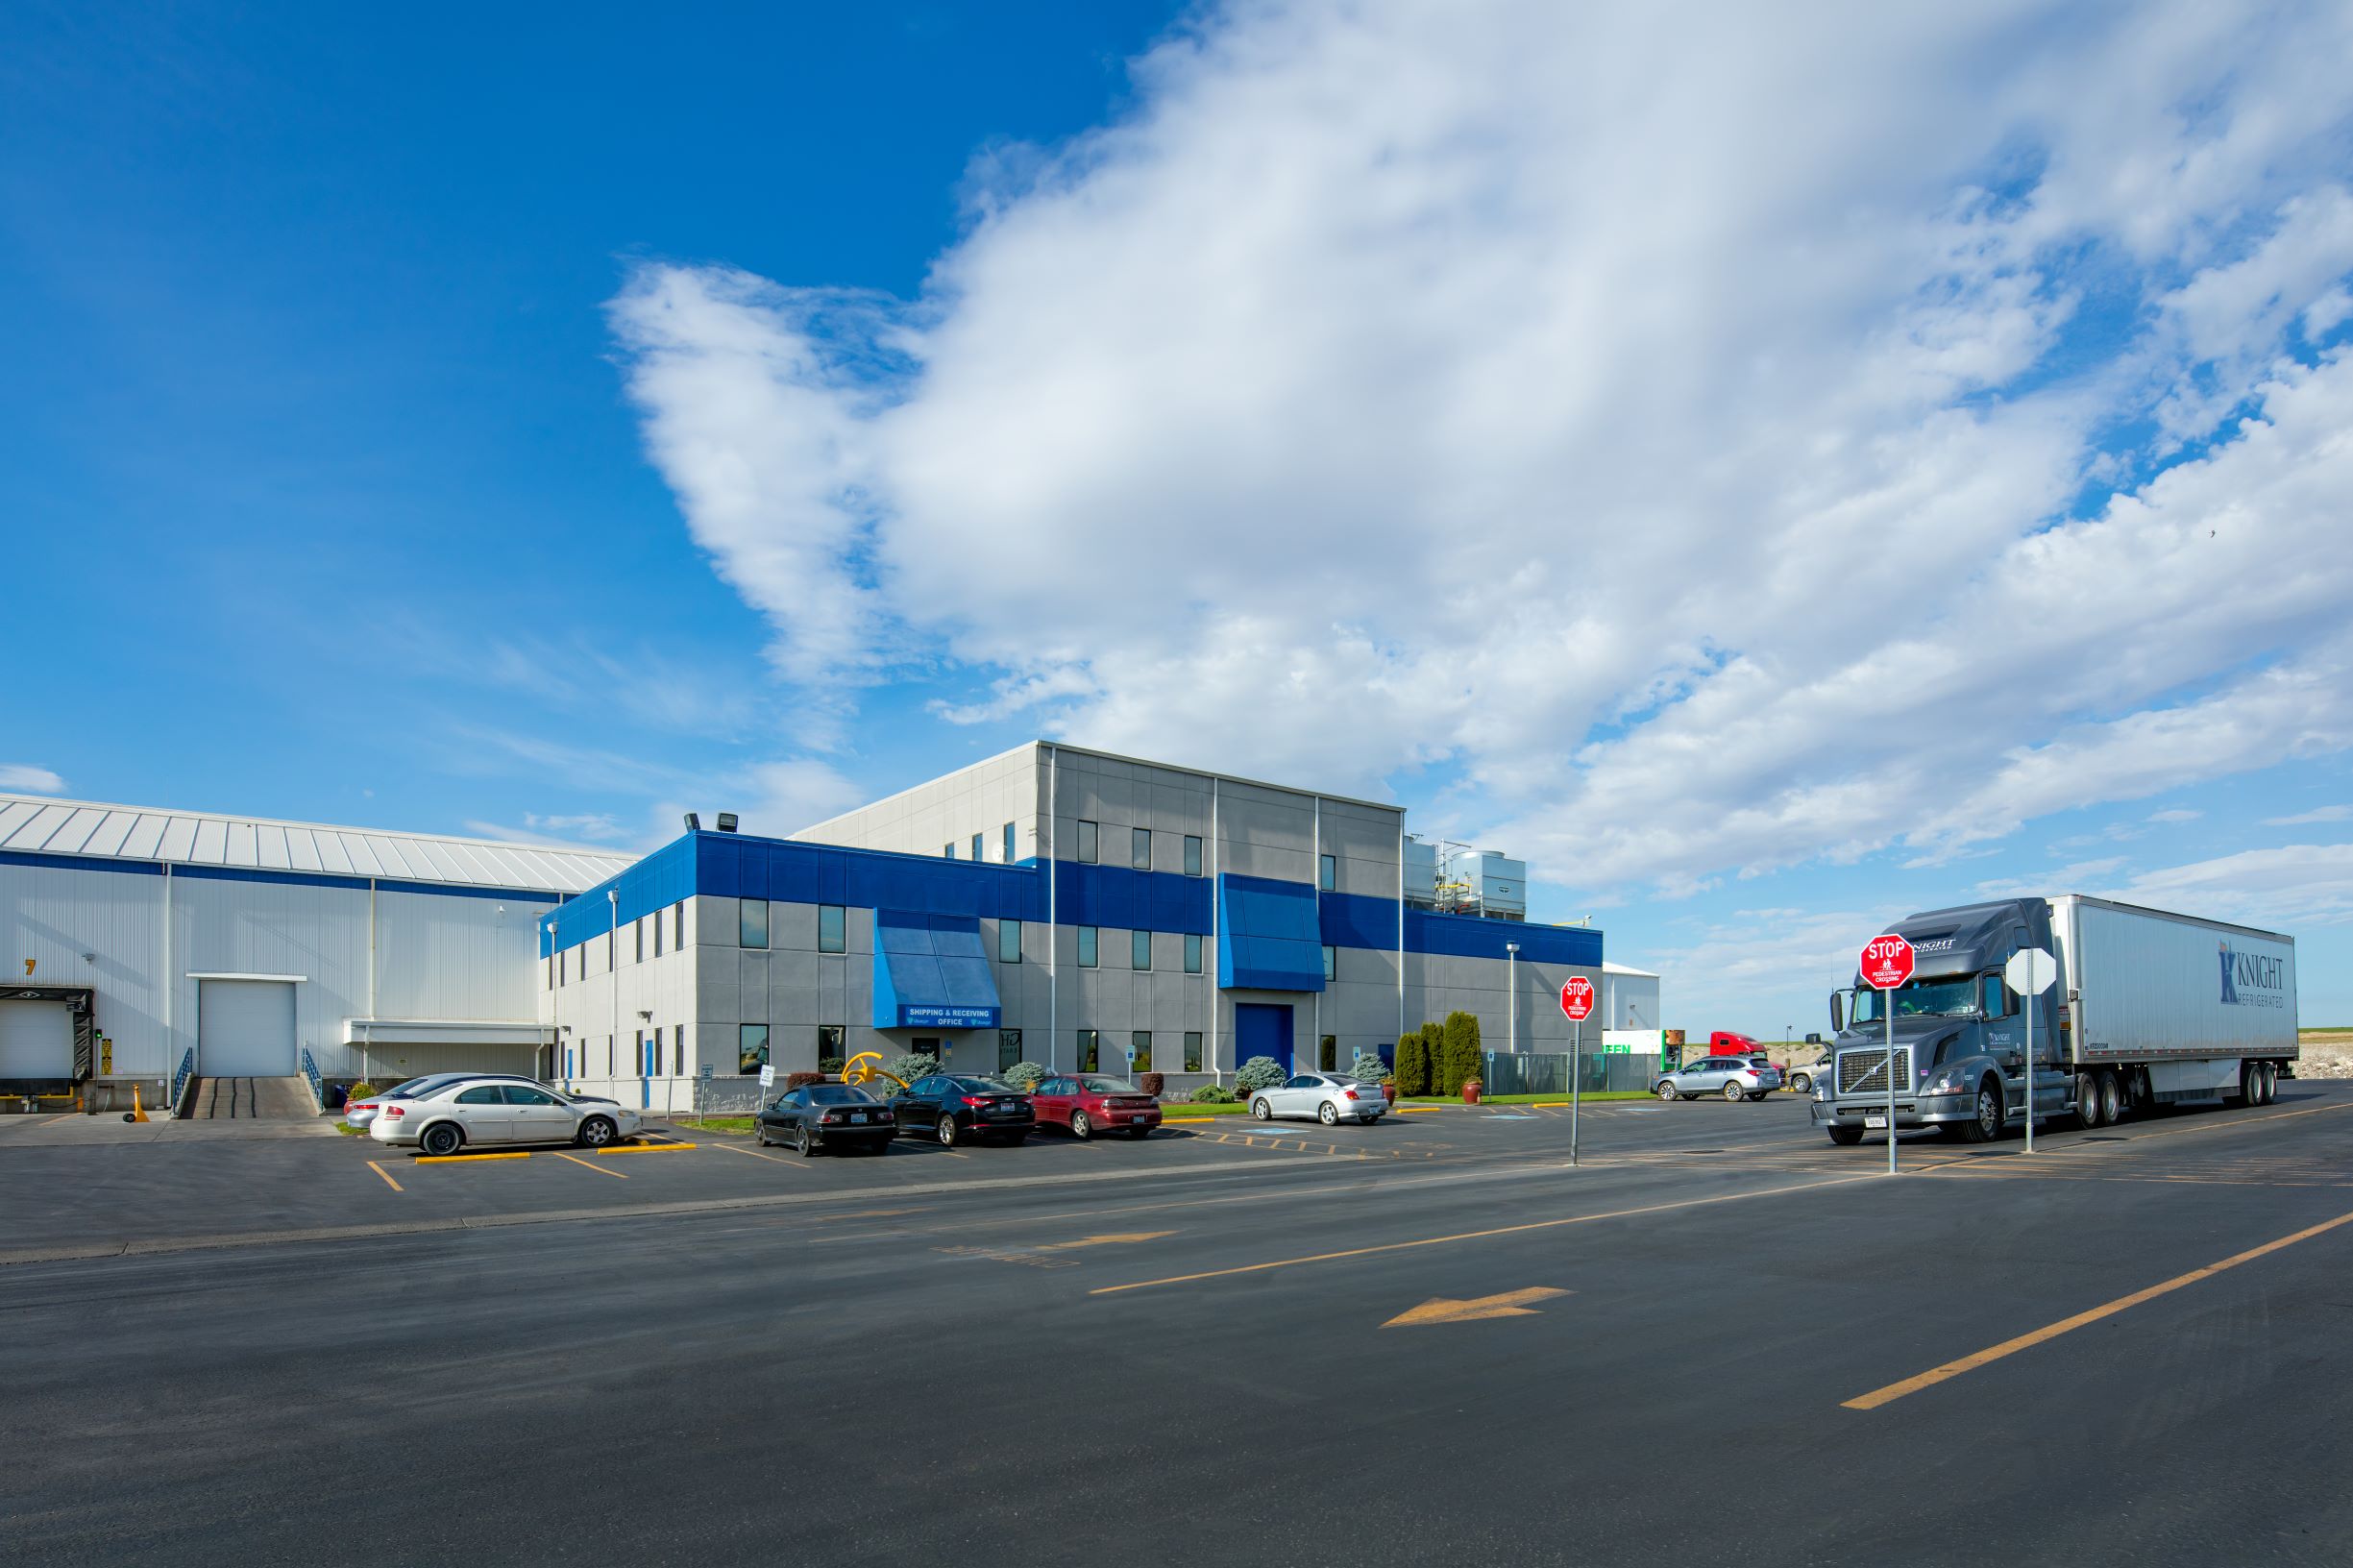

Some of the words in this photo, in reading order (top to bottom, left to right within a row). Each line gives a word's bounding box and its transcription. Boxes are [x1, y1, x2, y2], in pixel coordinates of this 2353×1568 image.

[1869, 942, 1905, 960] STOP
[1913, 939, 1956, 950] NIGHT
[25, 959, 37, 976] 7
[2237, 952, 2283, 990] KNIGHT
[1567, 982, 1589, 995] STOP
[2238, 993, 2283, 1008] REFRIGERATED
